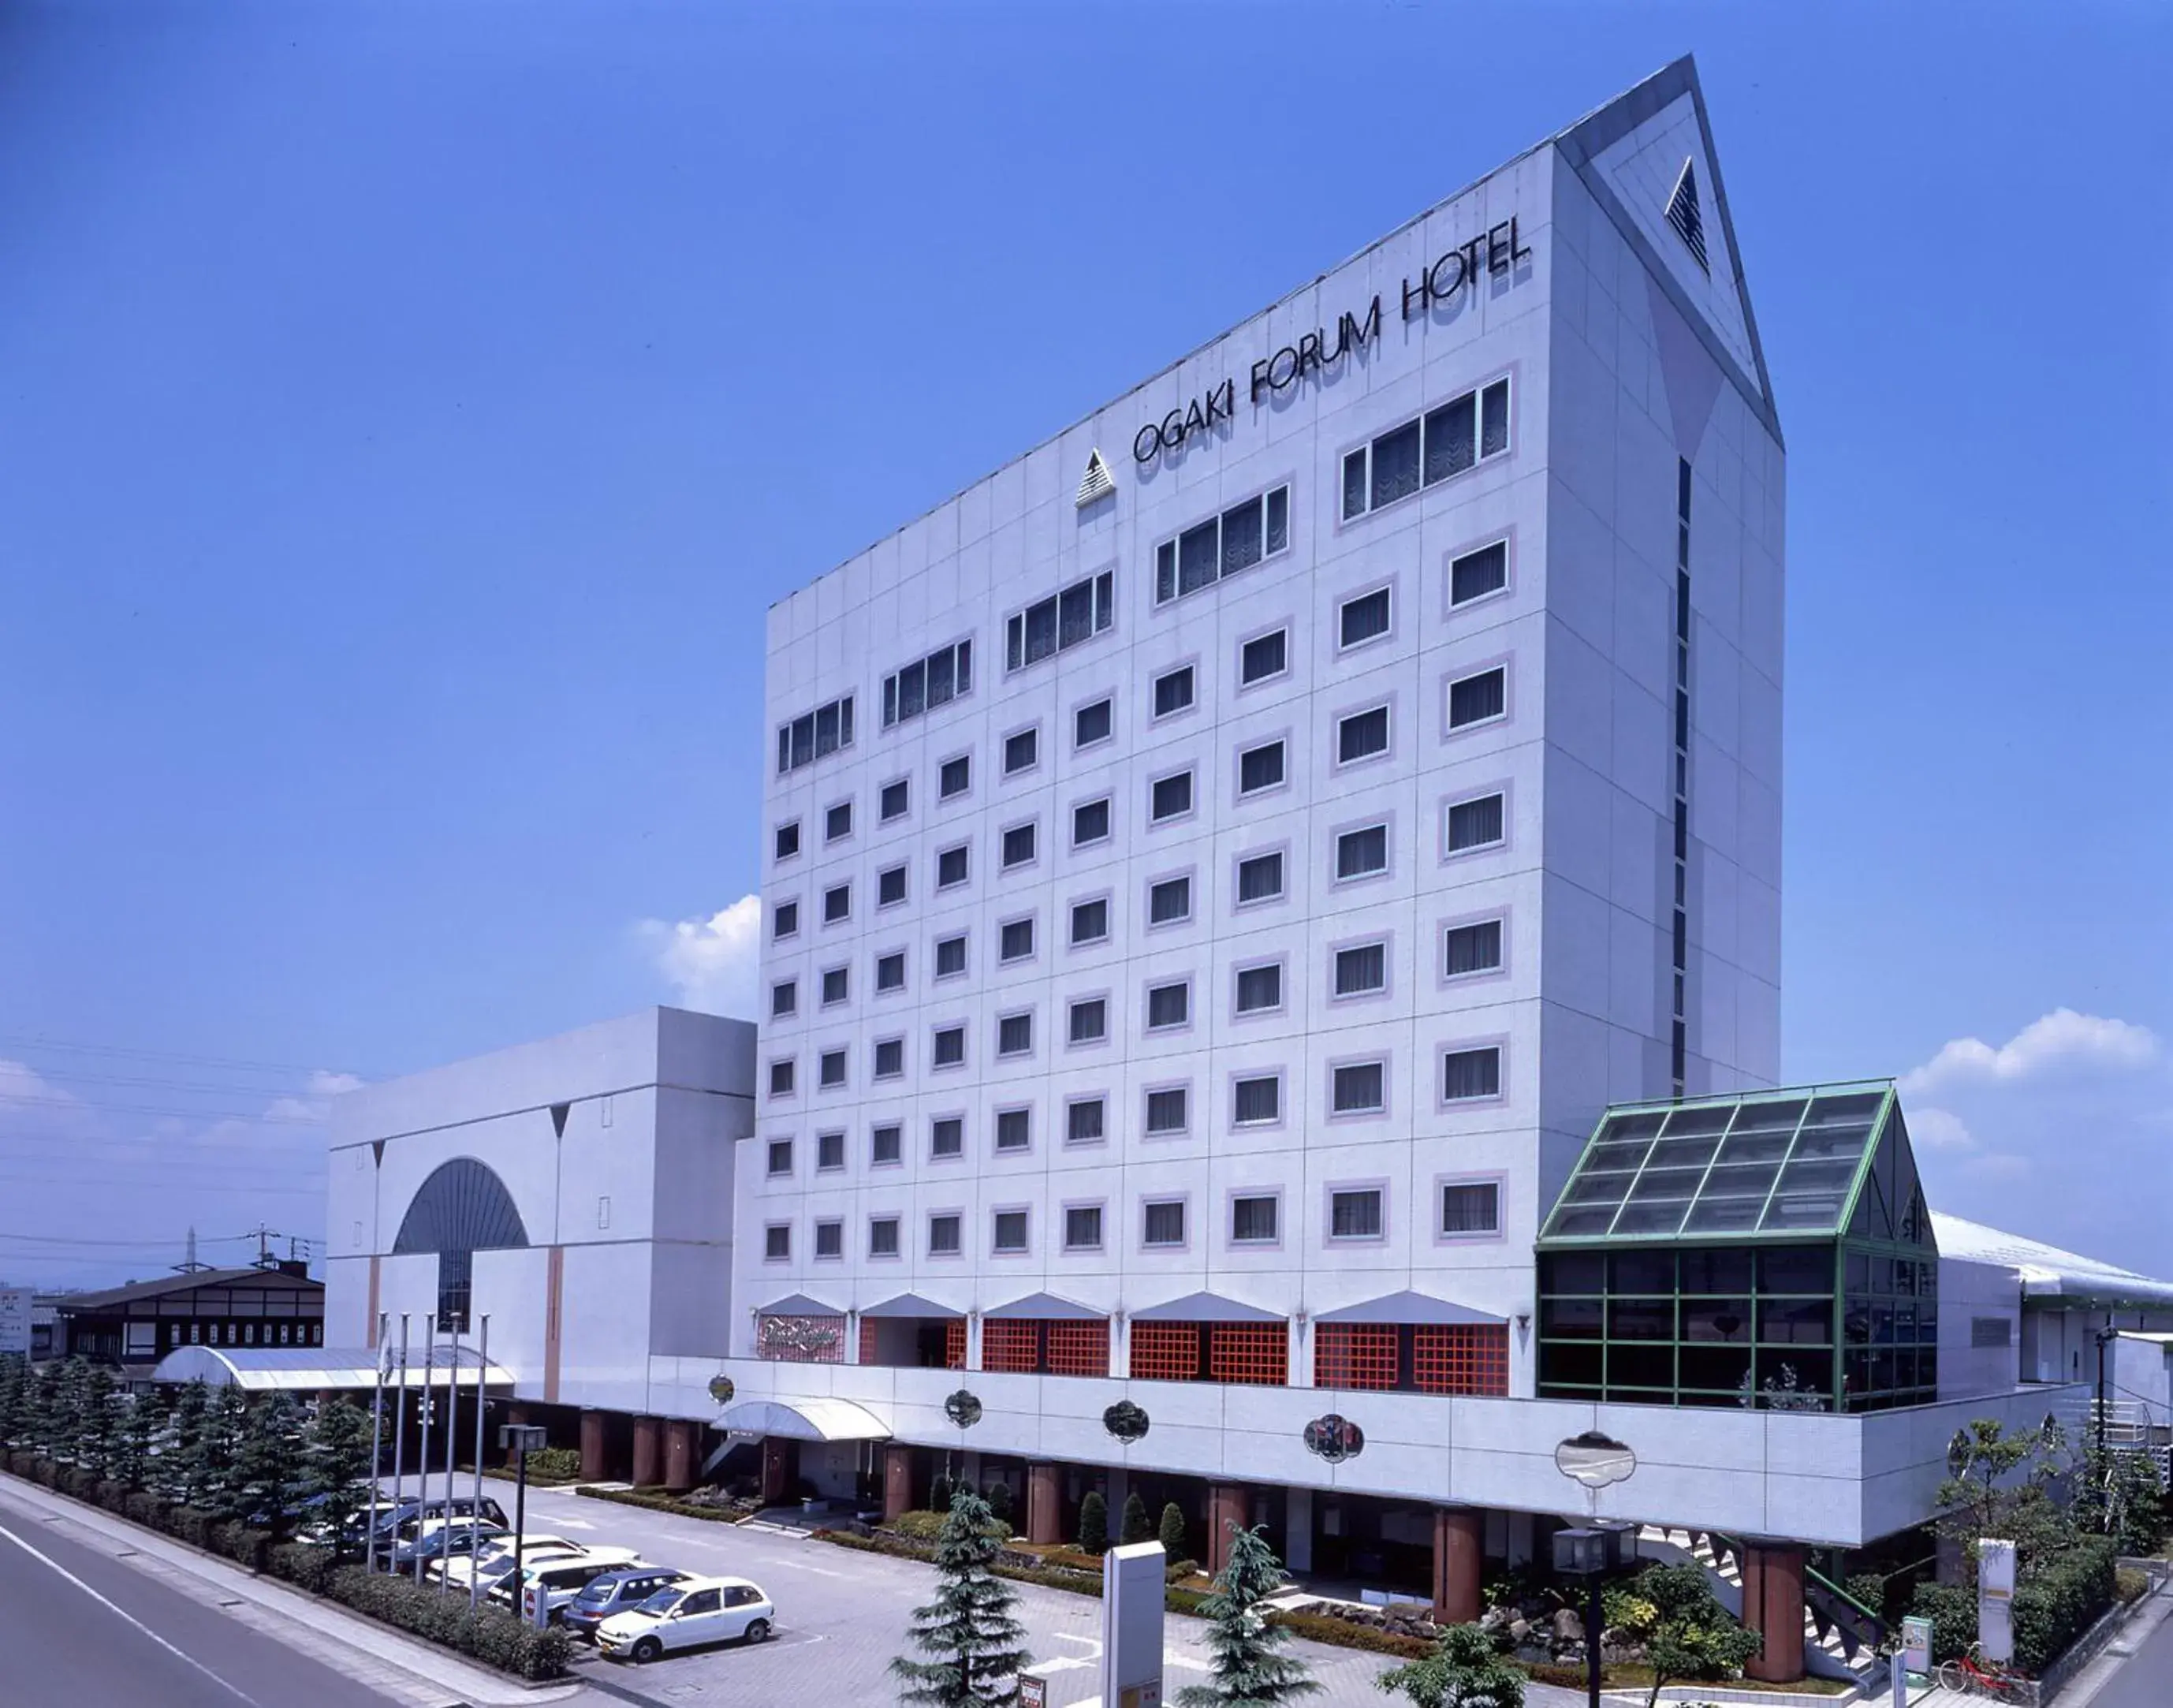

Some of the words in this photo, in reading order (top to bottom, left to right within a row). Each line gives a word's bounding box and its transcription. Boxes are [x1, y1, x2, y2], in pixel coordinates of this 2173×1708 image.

[1133, 378, 1234, 463] OGAKI
[1250, 296, 1381, 403] FORUM
[1402, 215, 1532, 321] HOTEL
